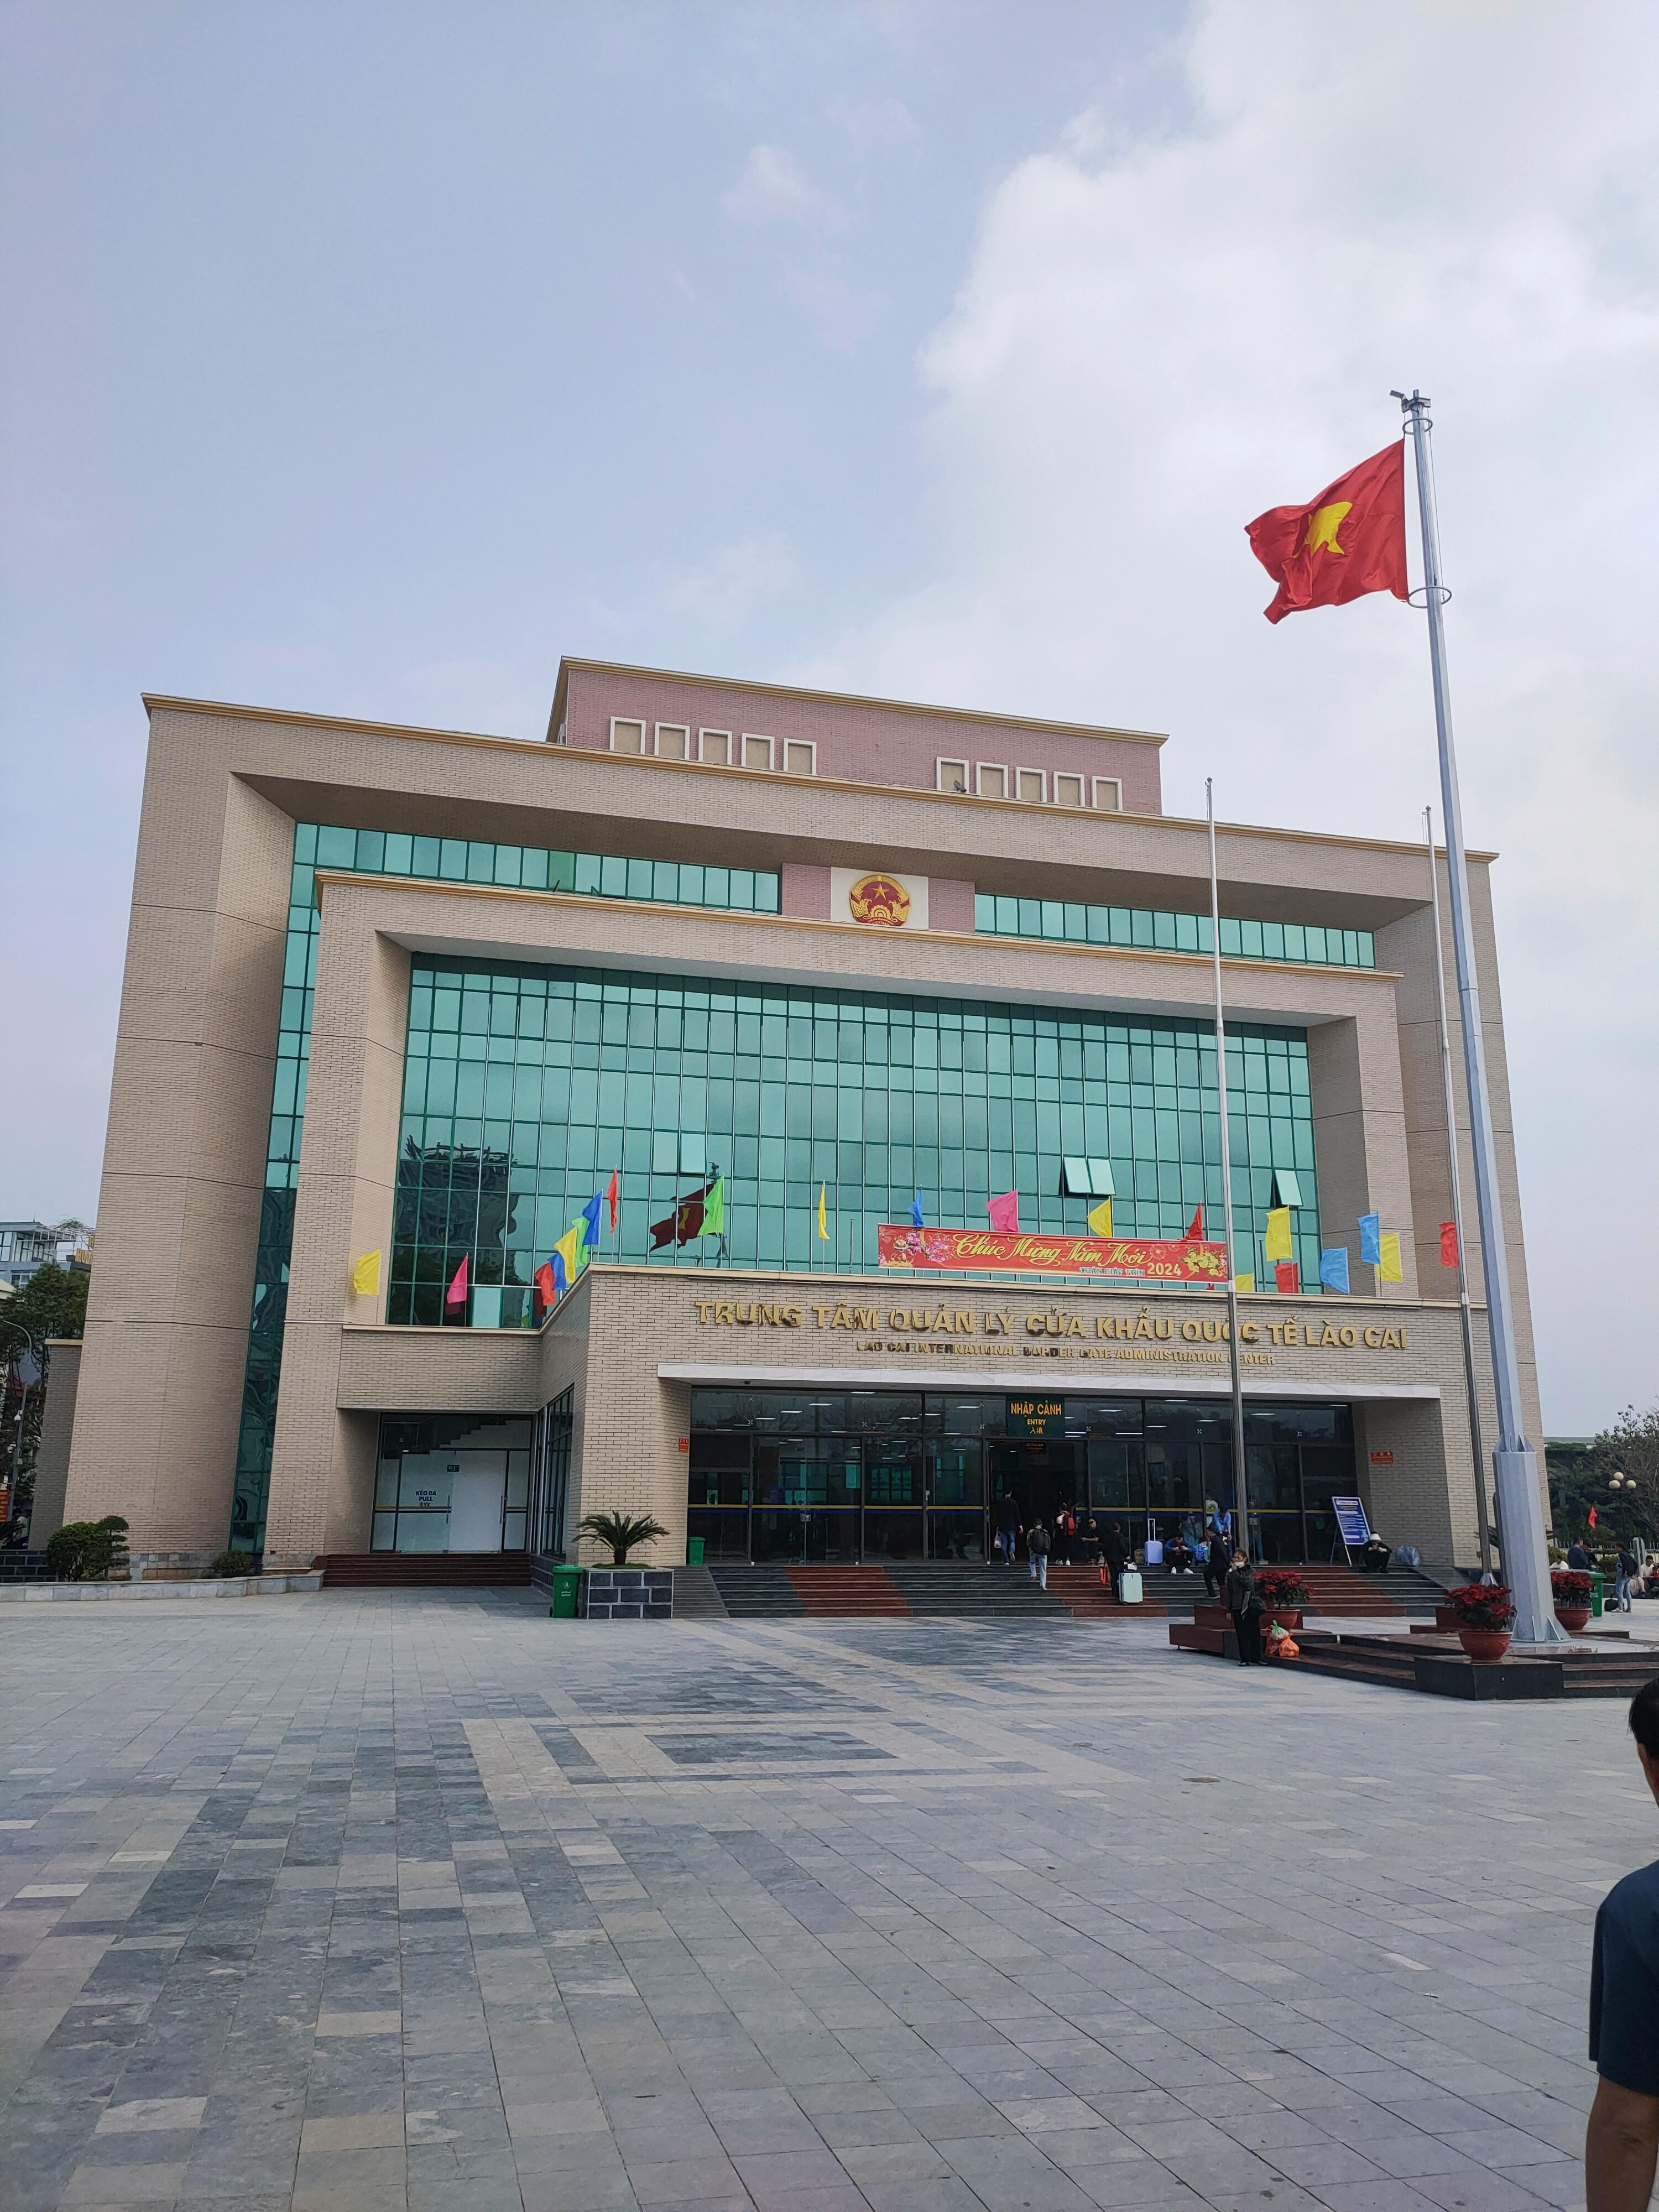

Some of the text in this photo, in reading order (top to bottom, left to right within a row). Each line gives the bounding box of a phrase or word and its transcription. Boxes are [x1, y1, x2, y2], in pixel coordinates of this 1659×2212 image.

[953, 1233, 1152, 1268] Chúc Mừng Năm Mới
[1147, 1262, 1182, 1276] 2024
[695, 1301, 801, 1327] TRUNG
[812, 1300, 879, 1330] TÂM
[890, 1302, 974, 1333] QUẢN
[985, 1306, 1016, 1334] LÝ
[1026, 1306, 1087, 1337] CỬA
[1097, 1306, 1173, 1339] KHẨU
[1267, 1314, 1300, 1345] TẾ
[1305, 1319, 1358, 1347] LÀO
[1364, 1326, 1407, 1348] CAI
[857, 1341, 1275, 1365] LAO CAI INTERNATIONAL BORDER GATE ADMINISTRATION ENTER
[1011, 1400, 1062, 1417] NHẬP CẢNH
